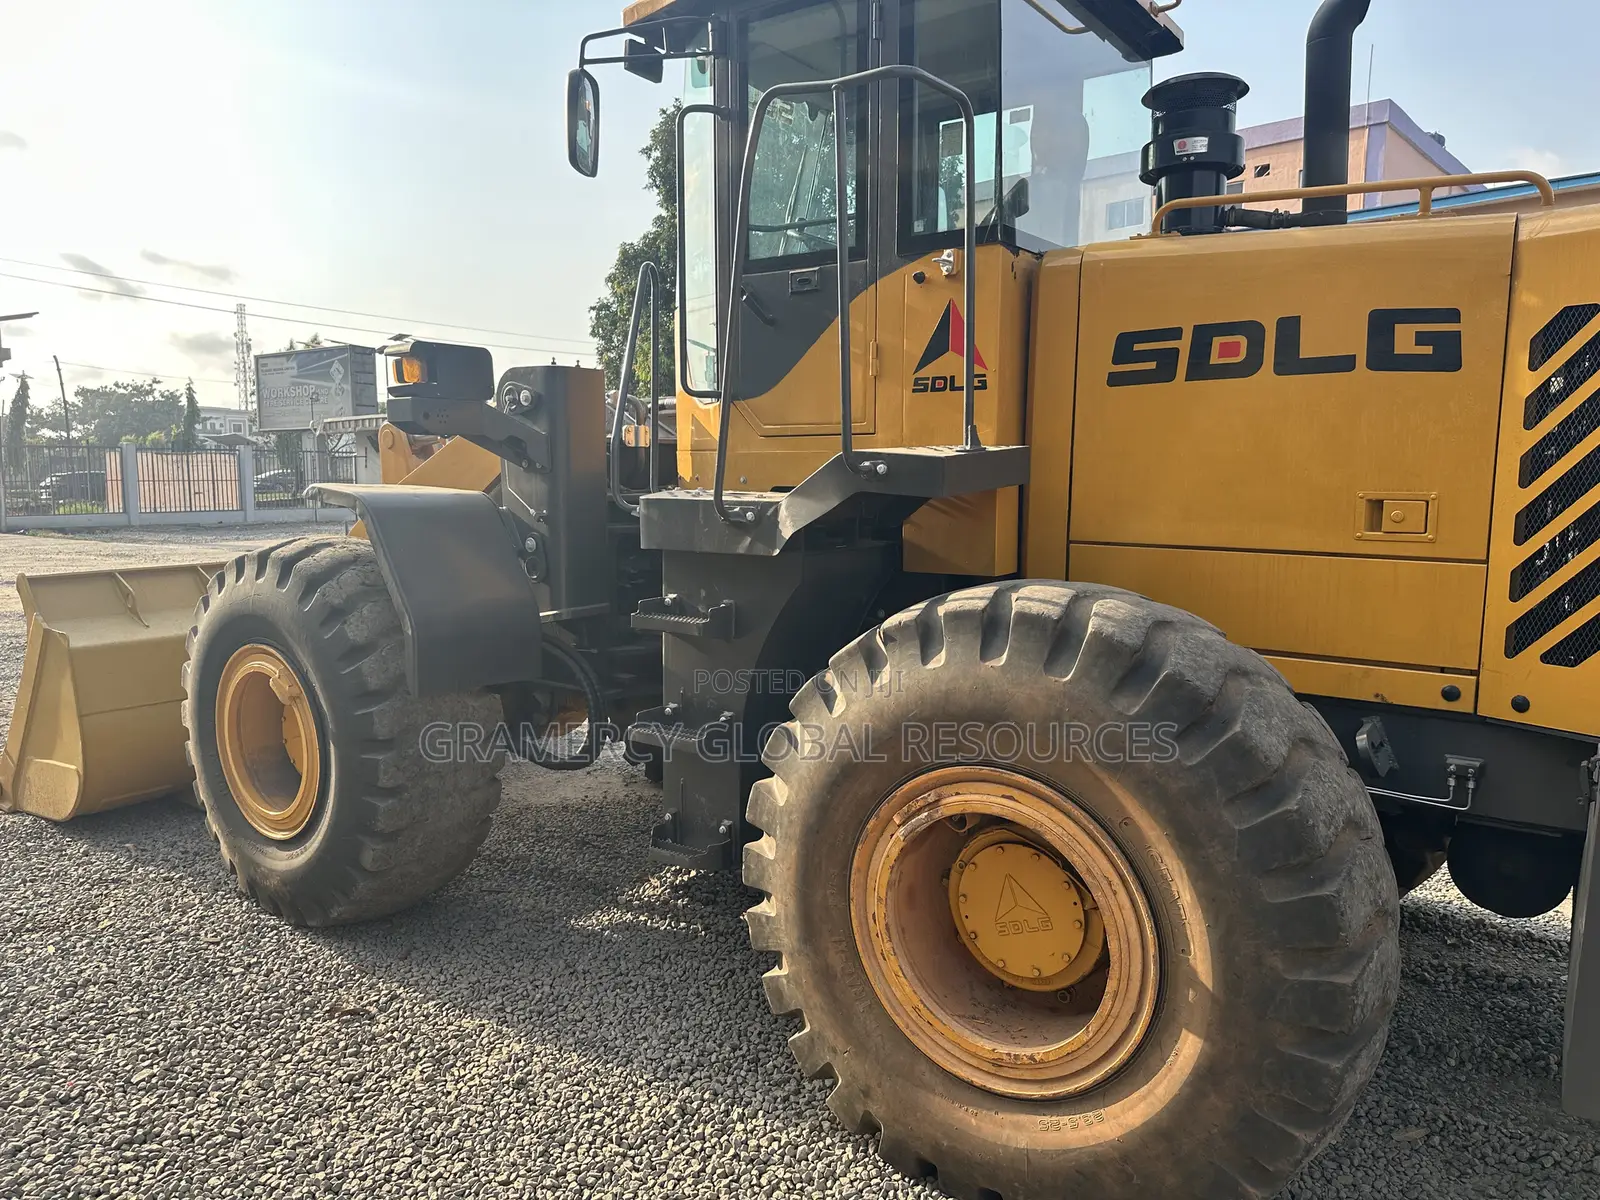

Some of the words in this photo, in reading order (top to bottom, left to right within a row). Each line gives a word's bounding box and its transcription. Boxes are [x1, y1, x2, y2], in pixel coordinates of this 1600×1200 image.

[1106, 307, 1462, 388] SDLG
[262, 386, 315, 398] WORKSHOP
[911, 373, 988, 394] SDLG
[280, 398, 304, 407] SERVICE
[995, 917, 1053, 936] SDLG
